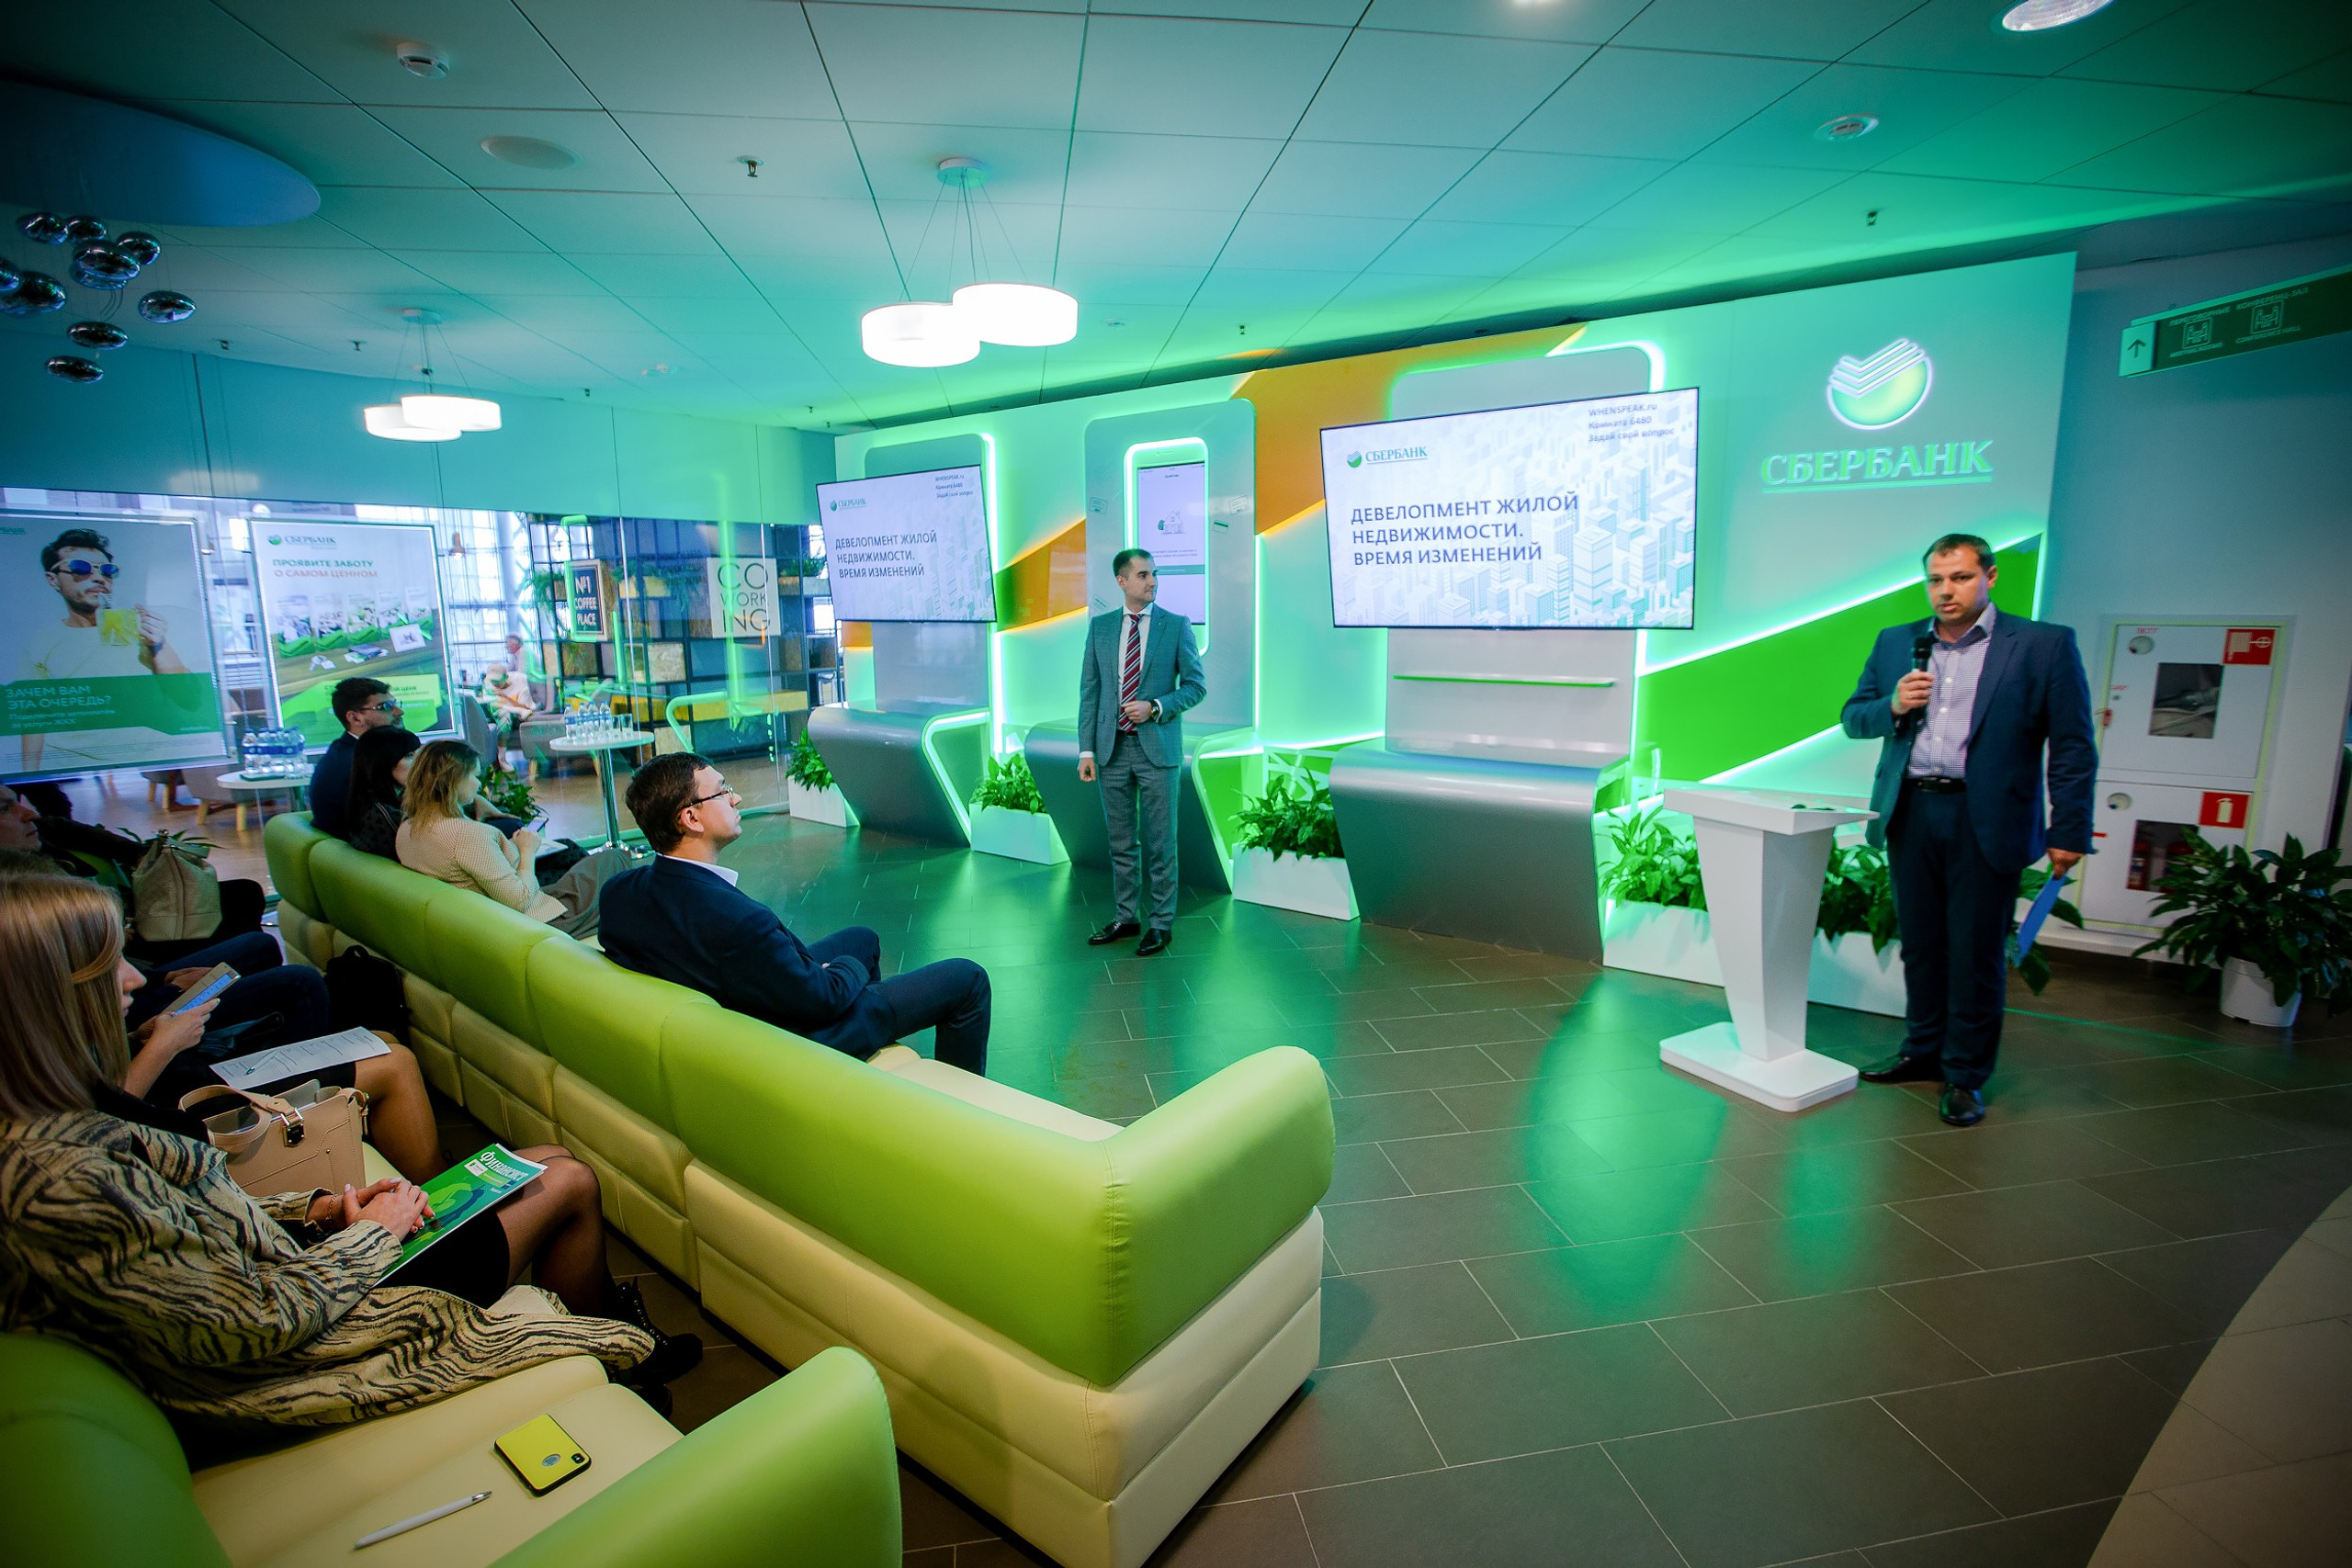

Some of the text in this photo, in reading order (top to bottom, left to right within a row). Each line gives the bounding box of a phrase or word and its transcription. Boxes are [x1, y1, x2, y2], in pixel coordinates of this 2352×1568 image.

[1365, 446, 1428, 461] СБЕРБАНК
[1760, 439, 1995, 486] СБЕРБАНК
[1351, 491, 1578, 525] ДЕВЕЛОПМЕНТ ЖИЛОЙ
[835, 530, 937, 550] ДЕВЕЛОПМЕНТ ЖИЛОЙ
[1352, 523, 1523, 545] НЕДВИЖИМОСТИ.
[837, 550, 915, 564] НЕДВИЖИМОСТИ.
[1354, 542, 1543, 566] ВРЕМЯ ИЗМЕНЕНИЙ
[272, 558, 374, 568] ПРОЯВИТЕ ЗАБОТУ
[286, 570, 329, 578] САМОМ
[332, 570, 378, 579] ЦЕННОМ
[718, 562, 769, 590] CO
[839, 563, 924, 579] ВРЕМЯ ИЗМЕНЕНИЙ
[574, 596, 597, 610] COFFEE
[720, 592, 769, 606] WORK
[577, 613, 596, 626] PLACE
[722, 608, 770, 633] ING
[6, 685, 92, 698] ЗАЧЕМ ВАМ
[7, 695, 112, 710] ЭТА ОЧЕРЕДЬ?
[479, 1151, 529, 1181] Финансист
